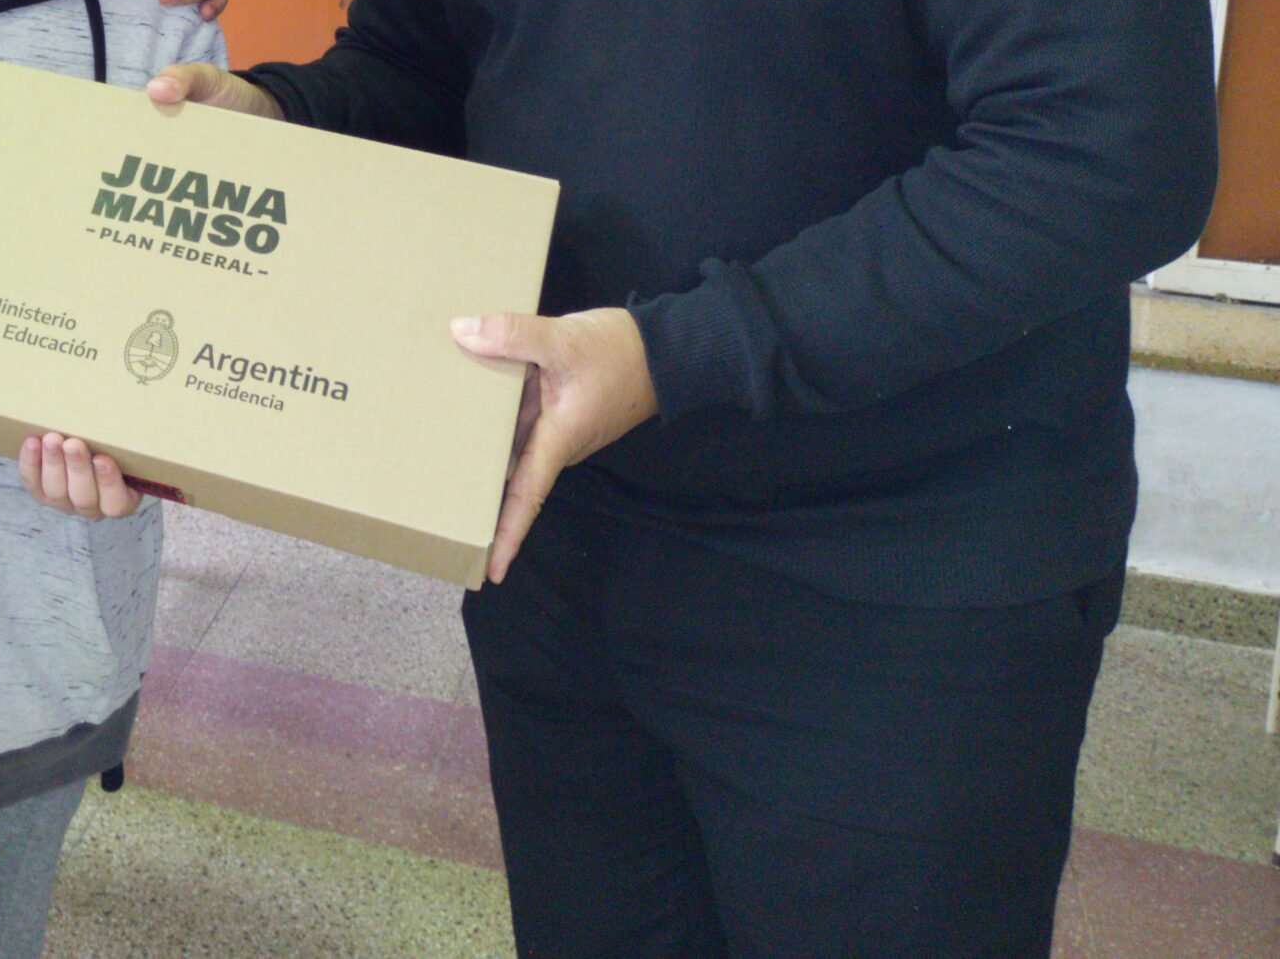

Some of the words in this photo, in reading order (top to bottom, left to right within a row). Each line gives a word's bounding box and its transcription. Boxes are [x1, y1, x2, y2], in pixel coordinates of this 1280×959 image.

[101, 154, 287, 225] JUANA
[91, 188, 280, 254] MANSO
[2, 323, 98, 361] Educación
[185, 374, 284, 411] Presidencia
[192, 343, 349, 402] Argentina
